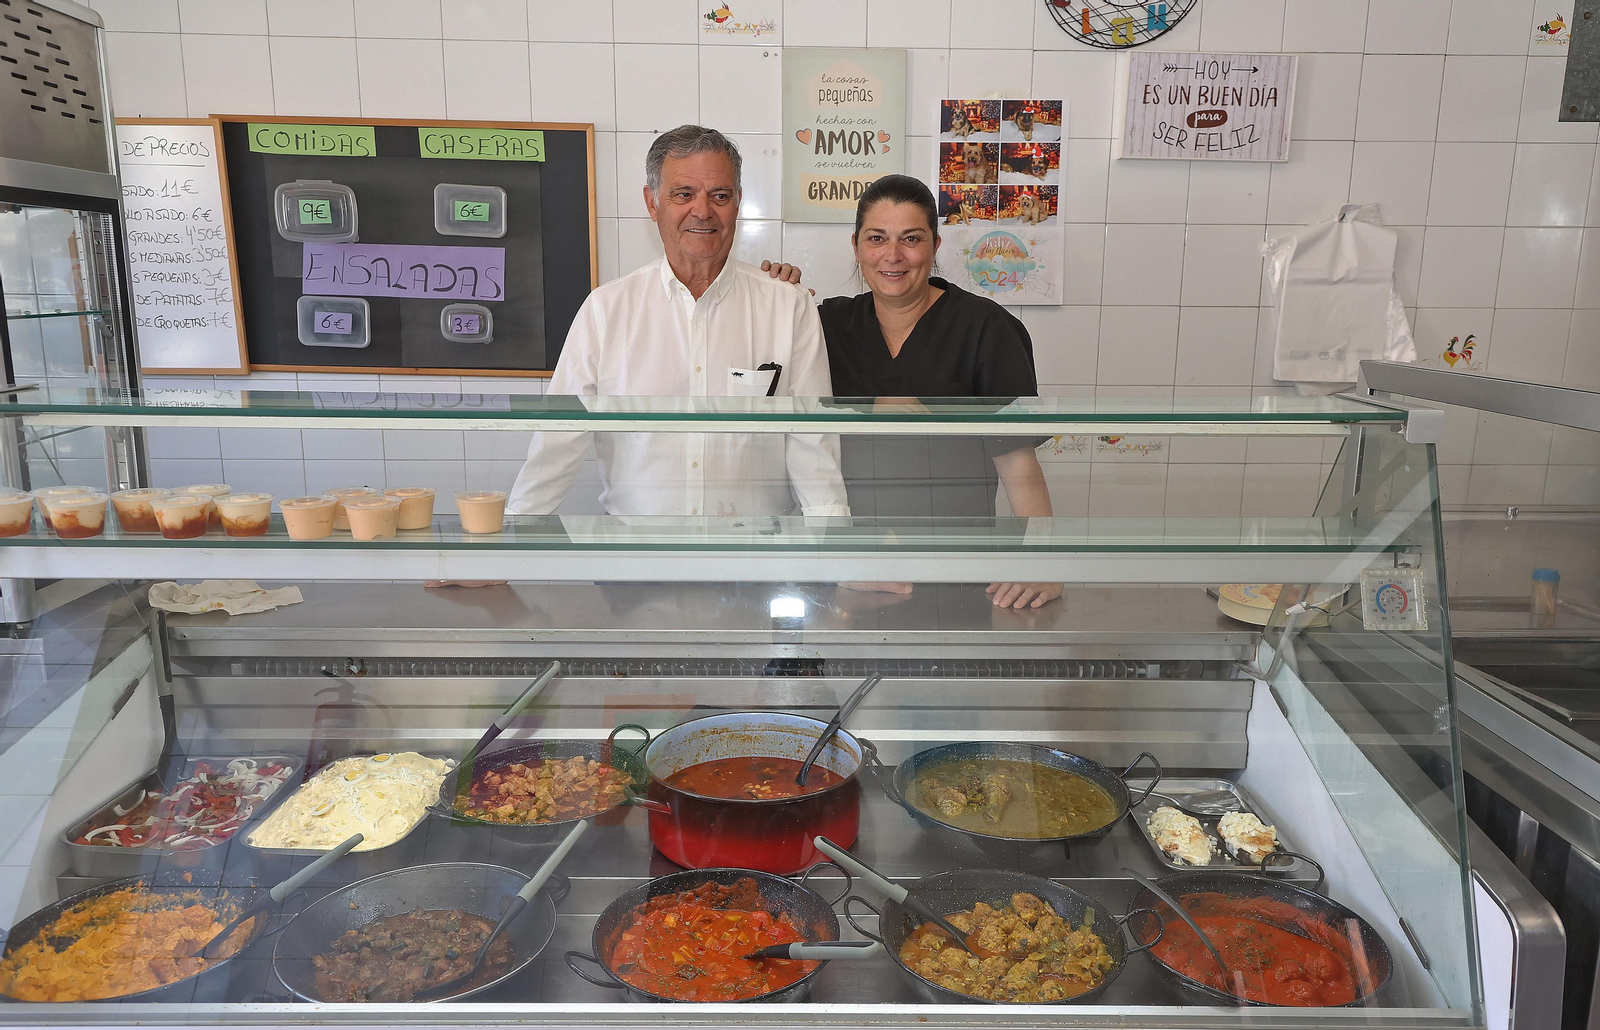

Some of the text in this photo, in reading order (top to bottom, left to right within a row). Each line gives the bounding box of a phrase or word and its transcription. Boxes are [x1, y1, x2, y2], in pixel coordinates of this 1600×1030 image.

[821, 74, 869, 84] la cosas
[1194, 60, 1231, 80] HOY
[818, 86, 874, 107] pequeñas
[1142, 84, 1278, 108] ES UN BUEN DÍA
[815, 115, 855, 125] hechas
[1193, 110, 1223, 128] para
[424, 133, 540, 158] CASERAS
[814, 128, 876, 156] AMOR
[1152, 121, 1260, 152] SER FELIZ
[121, 140, 146, 158] DE
[814, 158, 877, 169] se vuelven
[160, 179, 199, 198] 11€
[191, 207, 213, 223] 6€
[301, 202, 329, 222] 9€
[459, 203, 484, 219] 6€
[201, 267, 230, 287] 3€
[304, 250, 503, 299] ENSALADAS
[979, 268, 1019, 287] 2024
[136, 294, 152, 306] DE
[204, 287, 234, 306] 7€
[136, 317, 153, 328] DE
[320, 313, 346, 331] 6€
[454, 316, 476, 333] 3€
